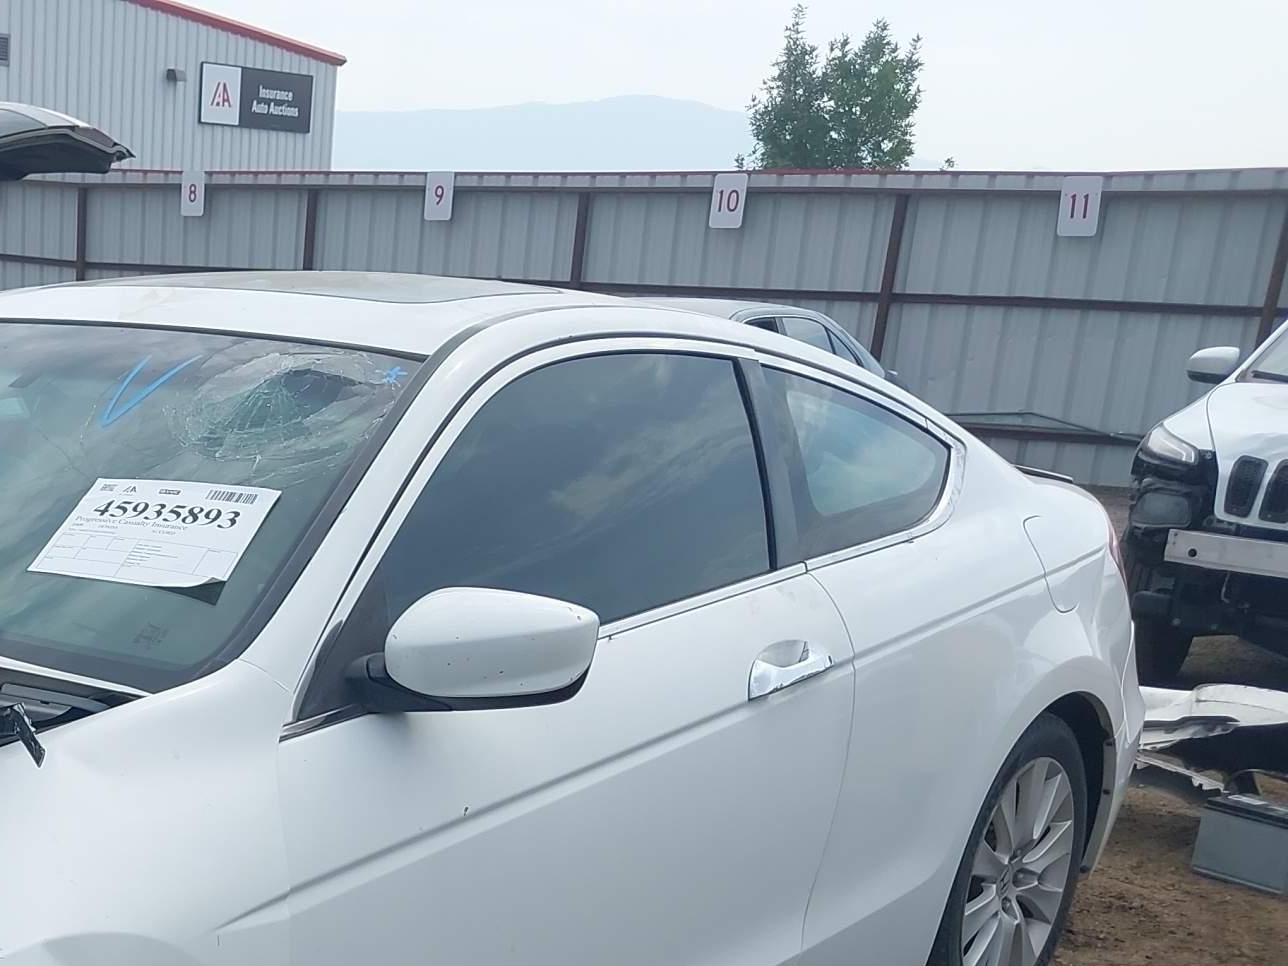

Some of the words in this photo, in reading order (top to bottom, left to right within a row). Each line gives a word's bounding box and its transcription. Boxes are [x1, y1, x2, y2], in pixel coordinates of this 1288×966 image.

[259, 84, 293, 101] Insurance
[252, 100, 268, 114] Auto
[269, 102, 299, 117] Auctions
[188, 183, 197, 204] 8
[434, 185, 445, 206] 9
[717, 189, 740, 213] 10
[1069, 193, 1090, 220] 11
[93, 499, 241, 530] 45935893
